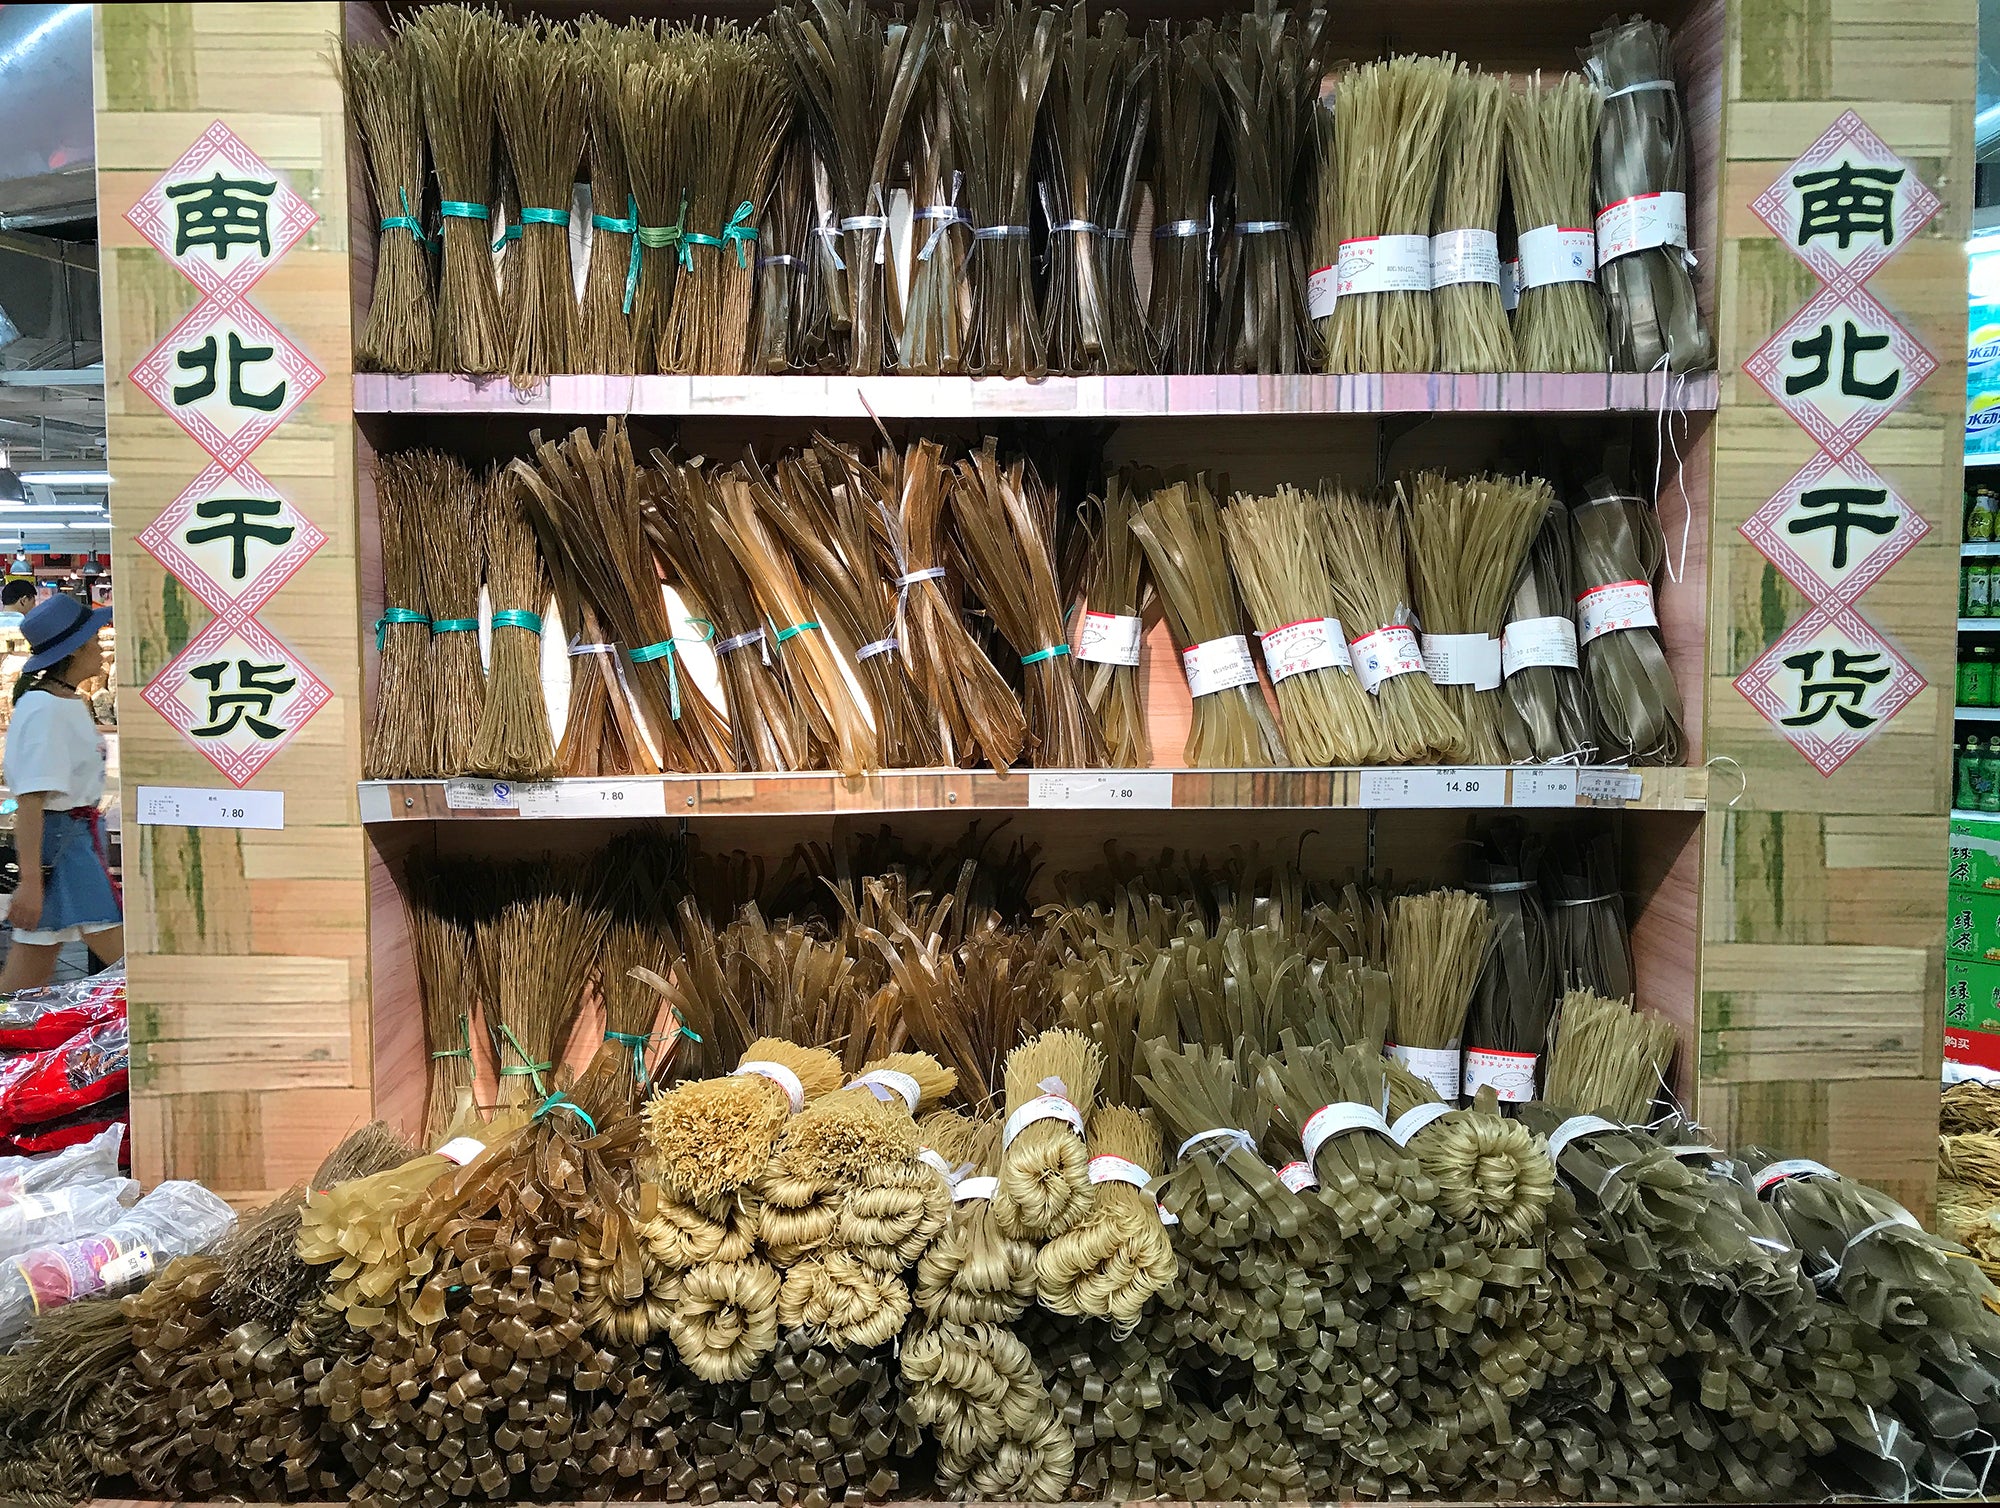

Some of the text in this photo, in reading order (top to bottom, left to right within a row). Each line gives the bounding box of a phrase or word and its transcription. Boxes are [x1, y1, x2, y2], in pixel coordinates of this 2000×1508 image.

[1967, 344, 2000, 360] 水动
[1966, 410, 2000, 426] 水动
[1780, 160, 1906, 729] 南北干货
[165, 171, 296, 739] 南北干货
[1110, 789, 1133, 798] 7.80
[1446, 781, 1480, 792] 14.80
[600, 791, 624, 801] 7.80
[220, 808, 244, 818] 7.80
[1951, 910, 1975, 952] 绿茶
[1948, 980, 1971, 1021] 绿茶
